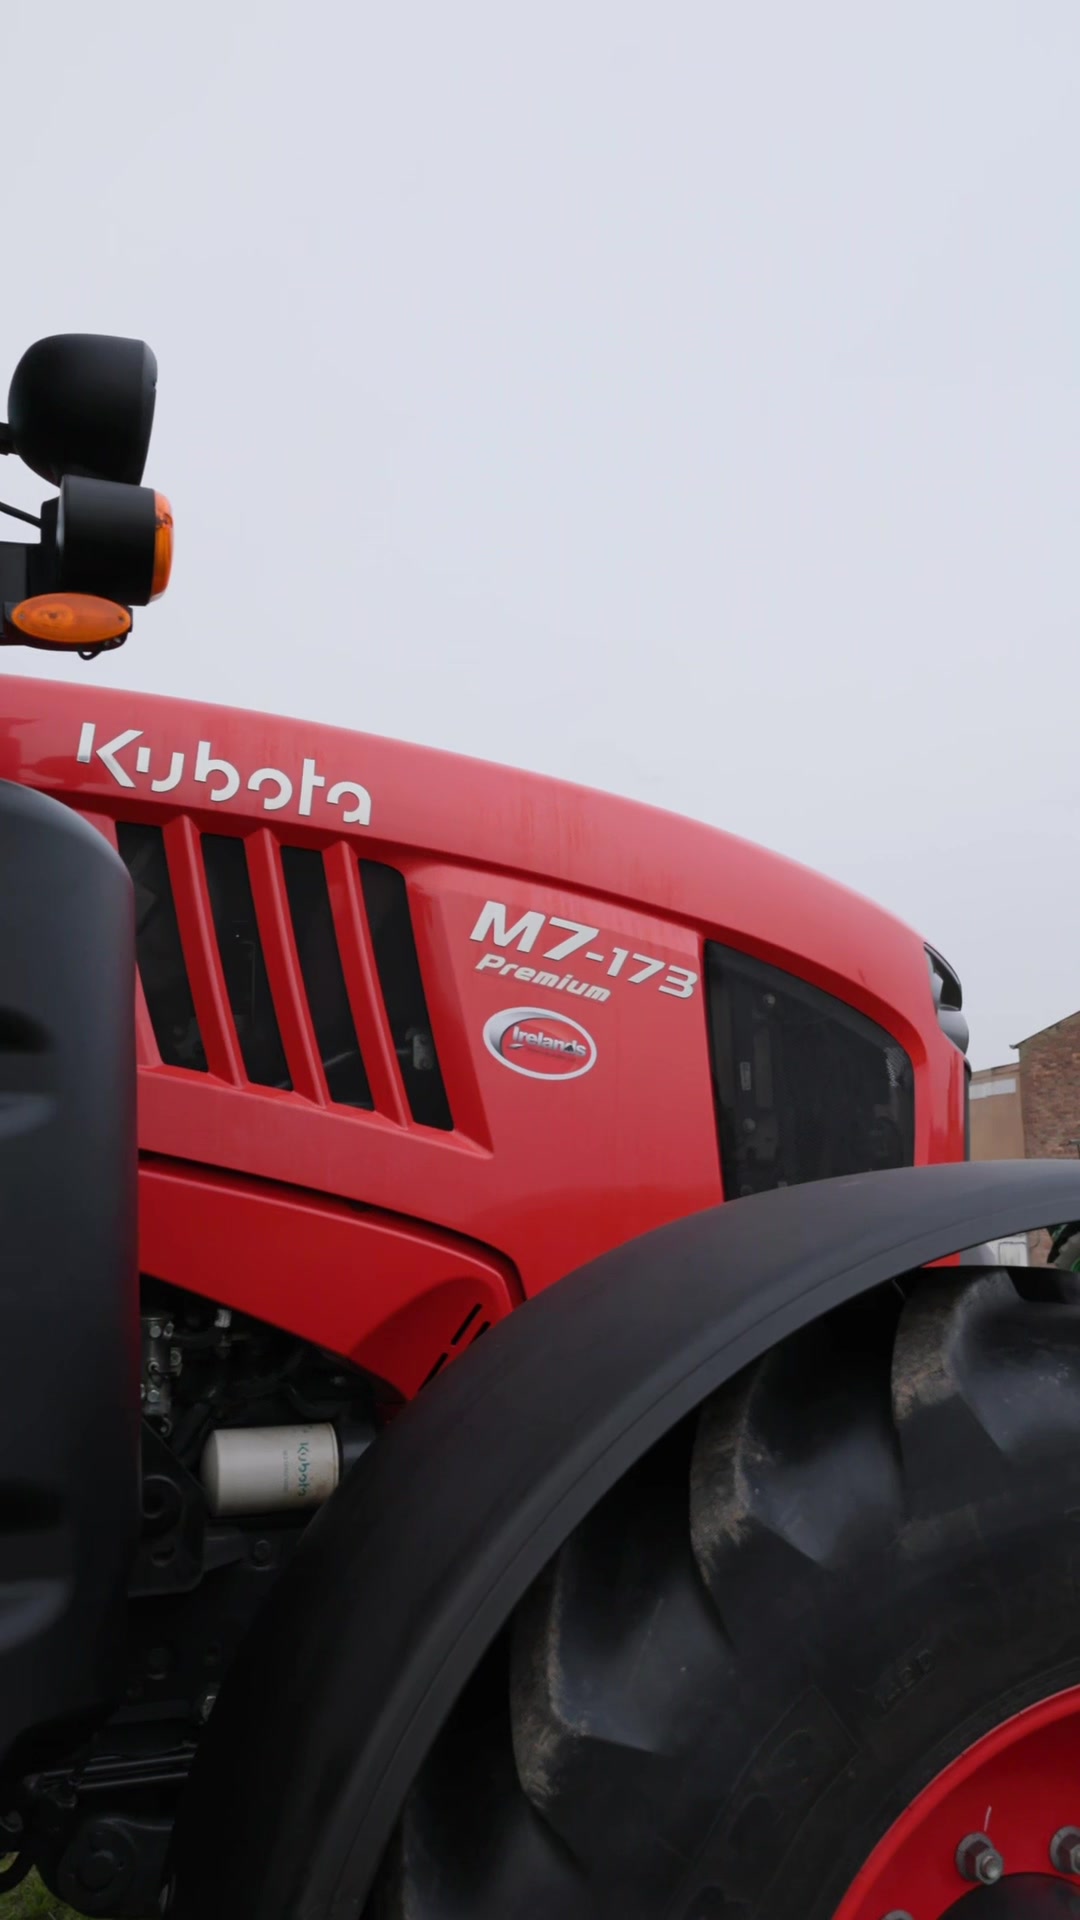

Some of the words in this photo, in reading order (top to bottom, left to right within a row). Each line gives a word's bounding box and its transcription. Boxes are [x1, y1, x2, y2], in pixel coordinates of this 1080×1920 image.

[77, 722, 371, 826] Kubota
[469, 900, 698, 999] M7-173
[475, 953, 611, 1002] Premium
[512, 1025, 587, 1057] Irelands
[297, 1442, 310, 1497] Kubota
